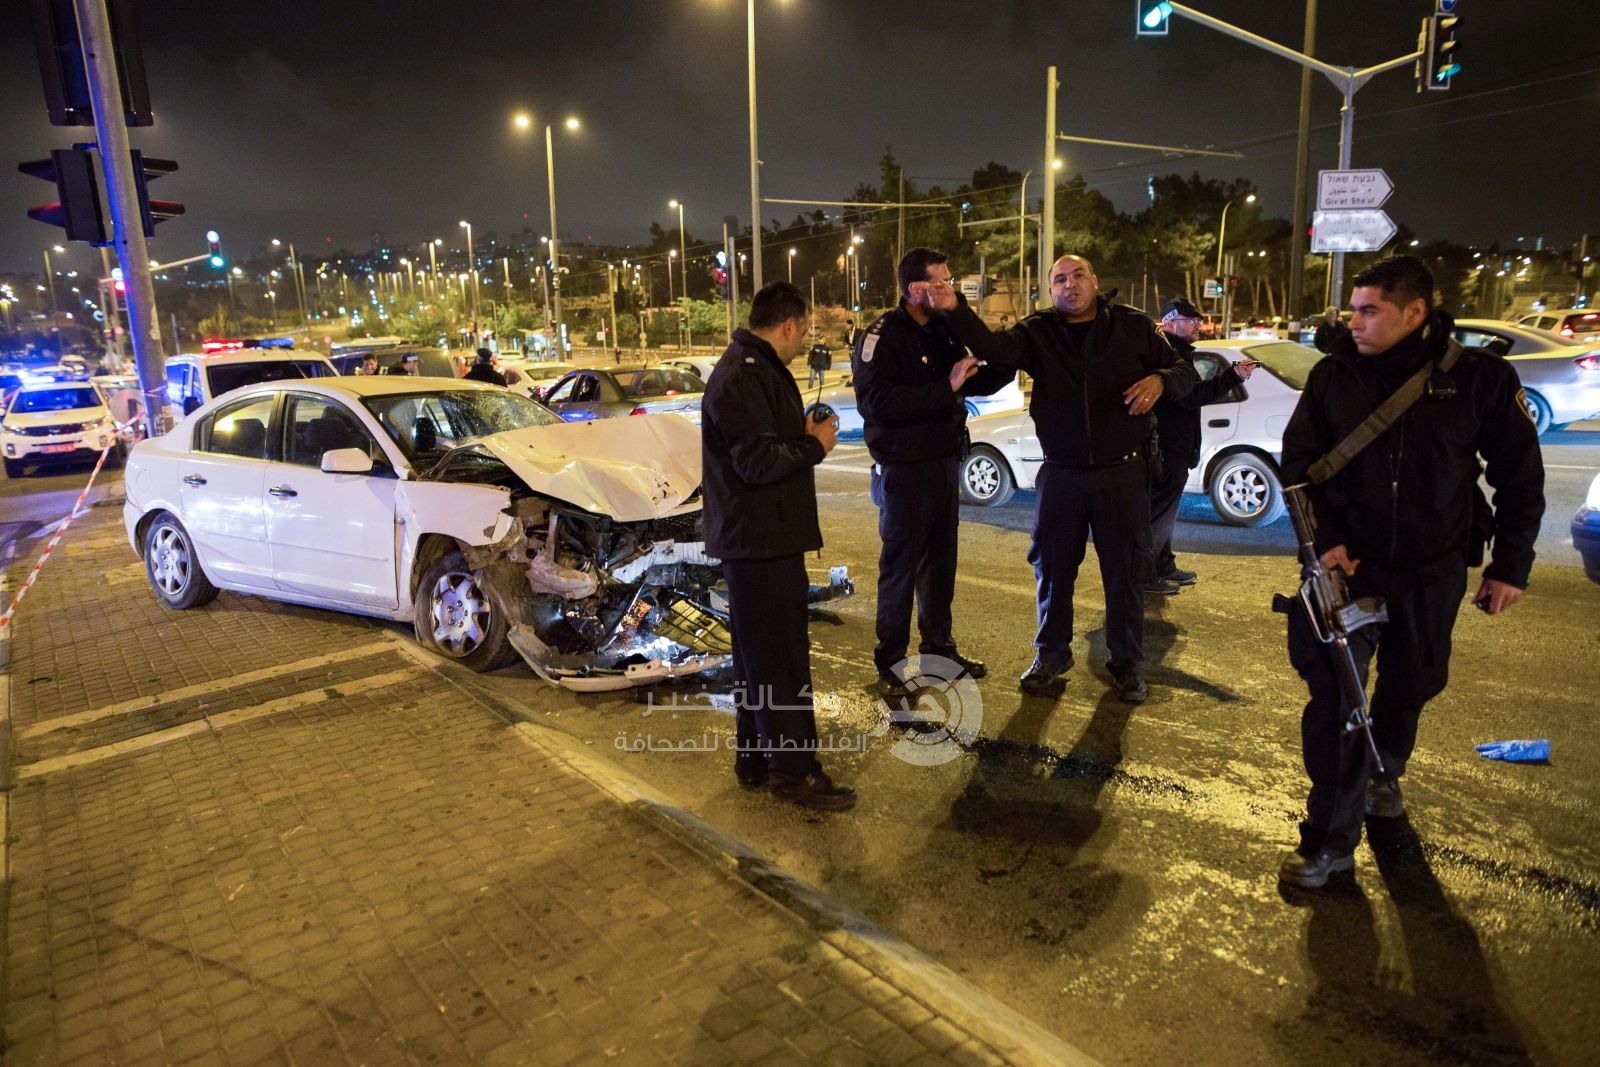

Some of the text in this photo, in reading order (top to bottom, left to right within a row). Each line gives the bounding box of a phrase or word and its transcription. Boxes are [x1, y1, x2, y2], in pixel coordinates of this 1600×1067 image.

[1327, 175, 1376, 183] גבעת שאול
[1325, 197, 1375, 205] Giv'at Sha'ul
